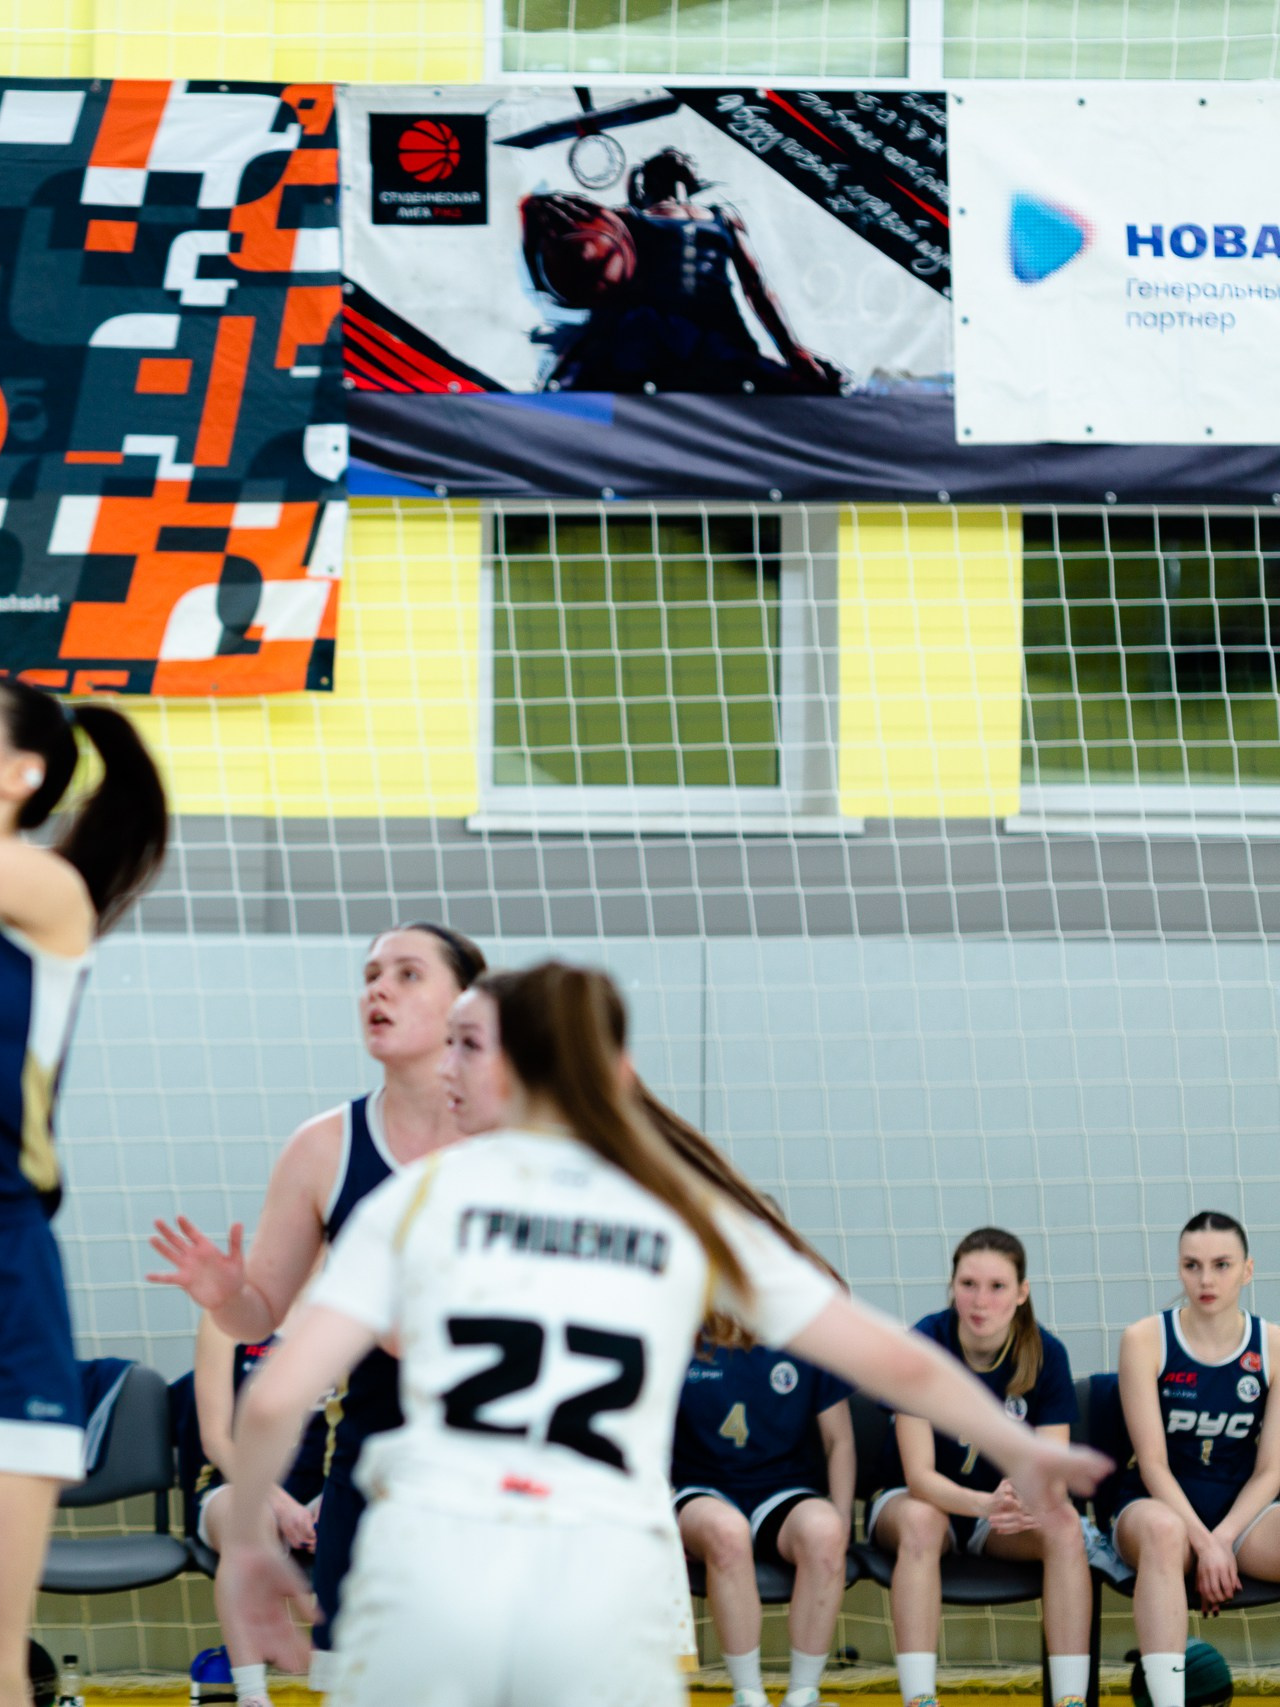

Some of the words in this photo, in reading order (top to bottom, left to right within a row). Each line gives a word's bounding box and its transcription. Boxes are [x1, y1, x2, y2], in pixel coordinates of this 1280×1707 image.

[1126, 223, 1280, 259] НОВА
[1126, 310, 1236, 334] партнер
[438, 1314, 646, 1478] 22
[719, 1402, 750, 1448] 4
[1166, 1408, 1256, 1440] РУС
[1200, 1439, 1214, 1466] 1
